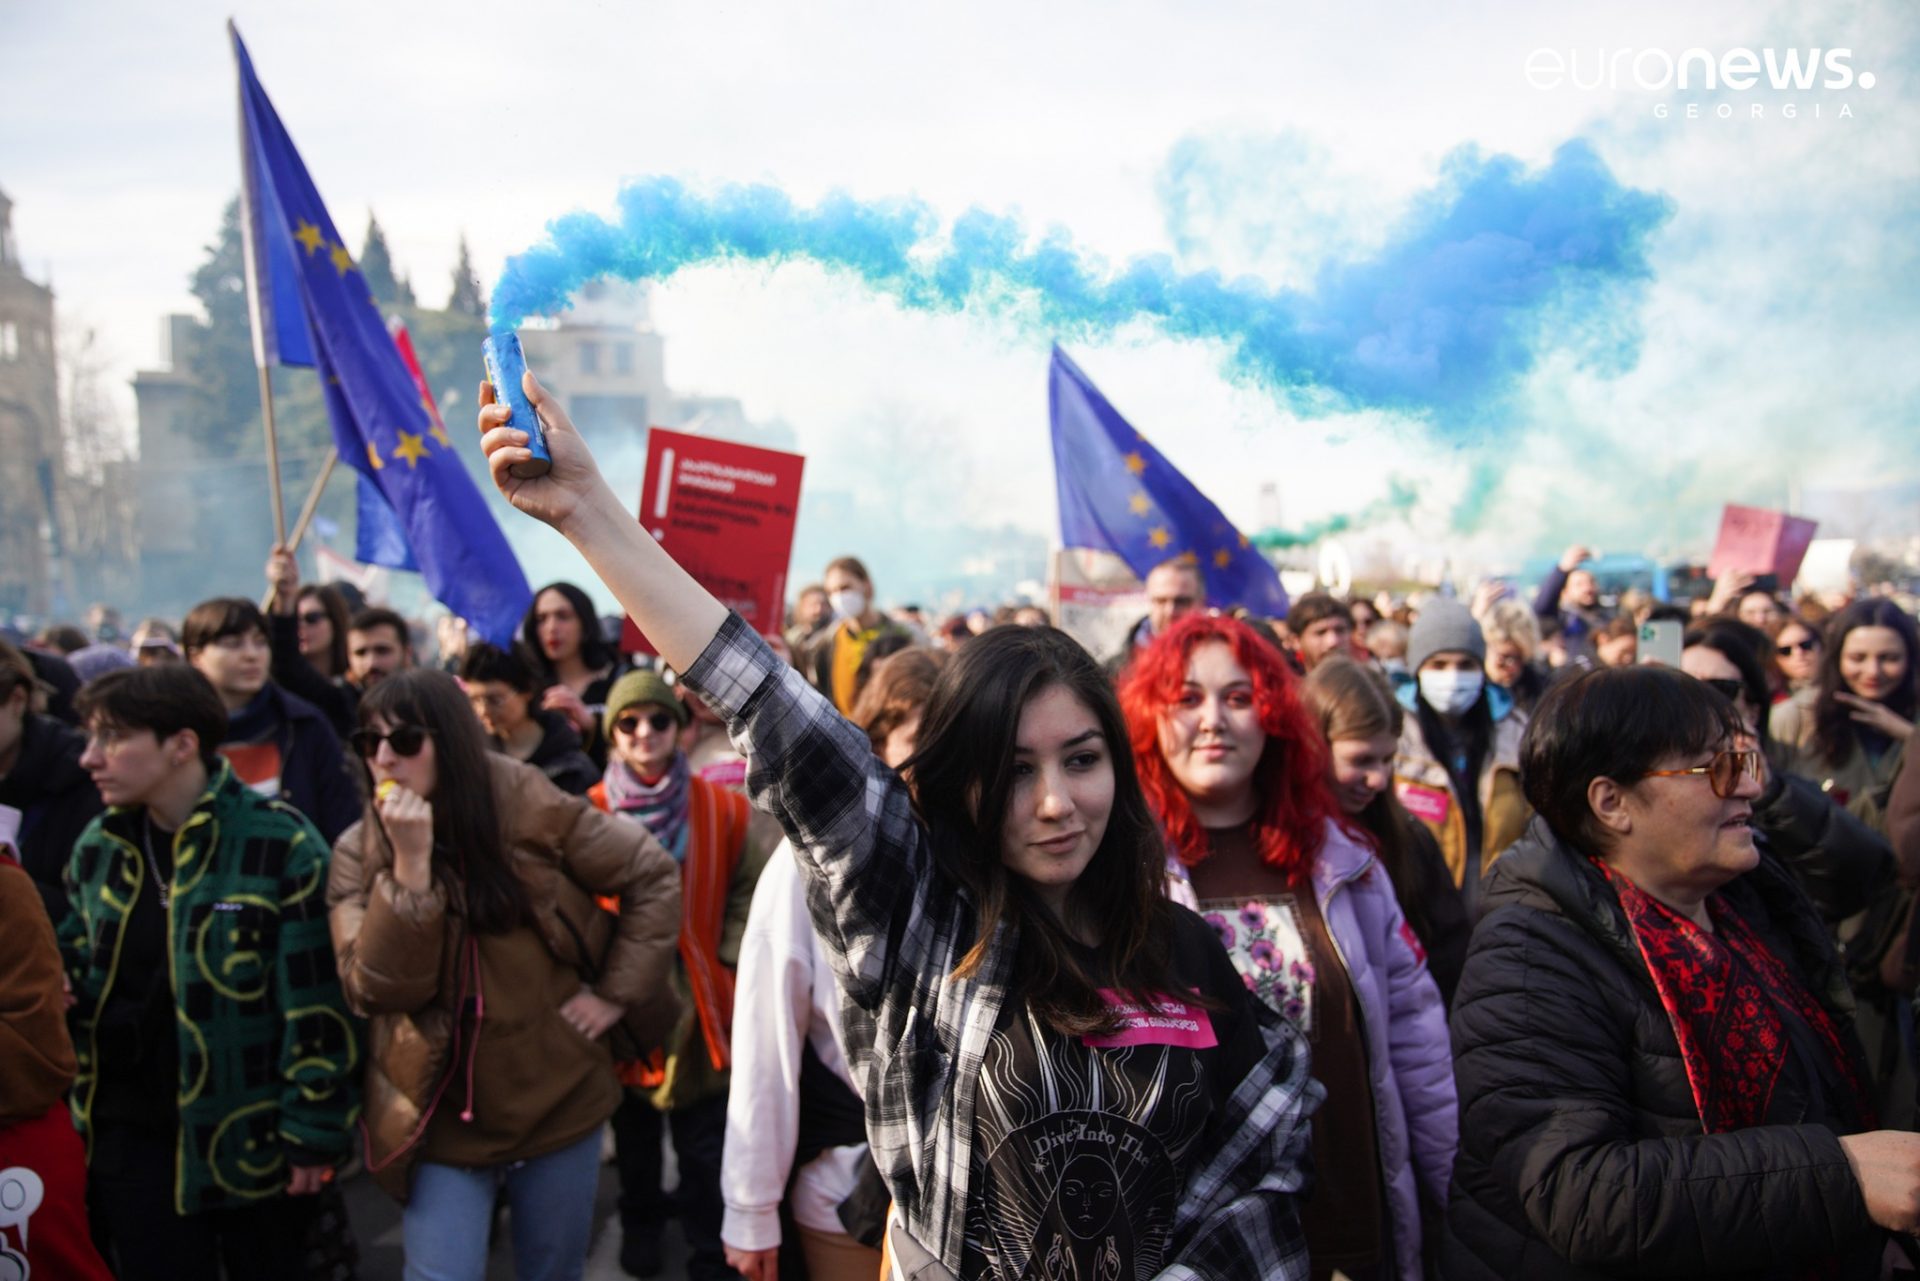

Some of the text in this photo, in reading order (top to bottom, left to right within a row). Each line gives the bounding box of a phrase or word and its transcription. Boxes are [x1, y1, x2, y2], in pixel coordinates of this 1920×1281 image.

[1033, 1124, 1149, 1165] Dive Into The
